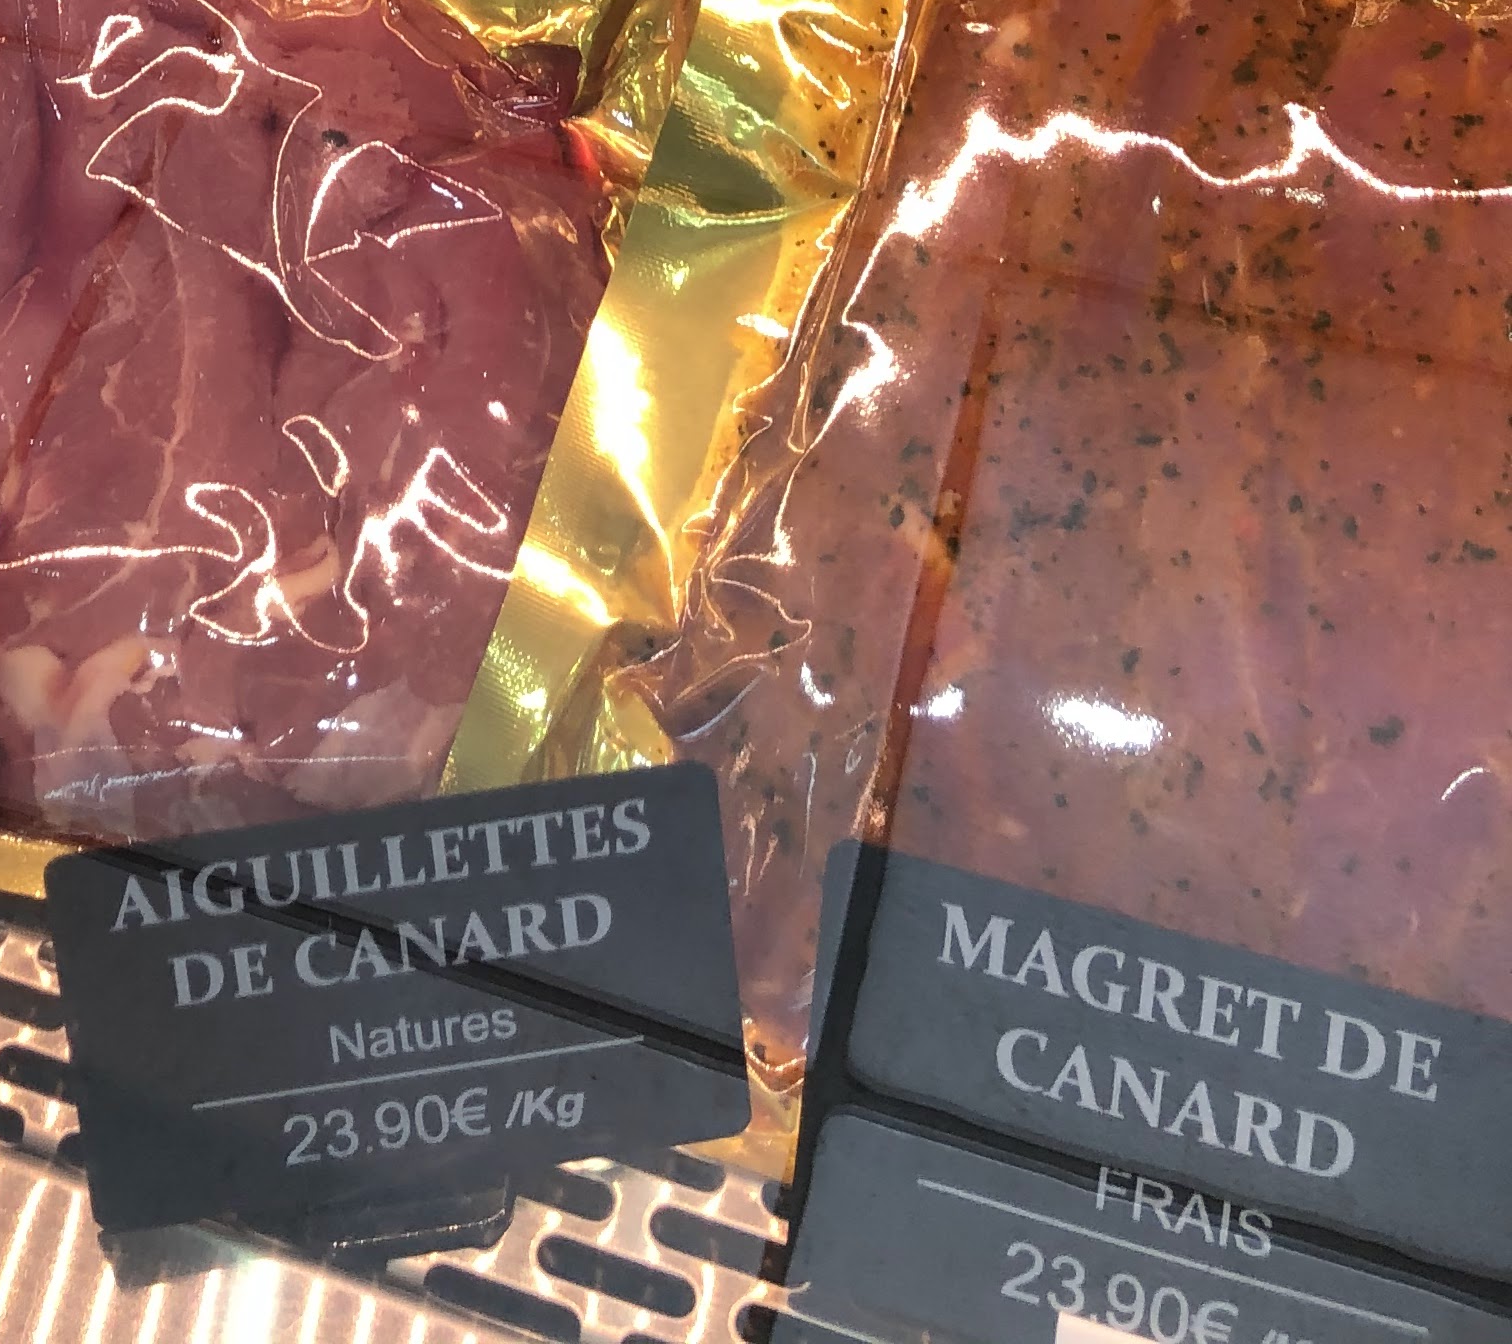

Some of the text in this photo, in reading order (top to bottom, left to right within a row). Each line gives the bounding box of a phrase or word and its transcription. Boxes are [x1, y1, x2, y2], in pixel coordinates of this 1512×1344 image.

[109, 796, 652, 933] AIGUILLETTES
[167, 892, 614, 1008] DE CANARD
[936, 900, 1444, 1103] MAGRET DE
[328, 1008, 518, 1064] Natures
[284, 1084, 585, 1167] 23.90€ /Kg
[995, 1027, 1356, 1180] CANARD
[1095, 1165, 1274, 1259] FRAIS
